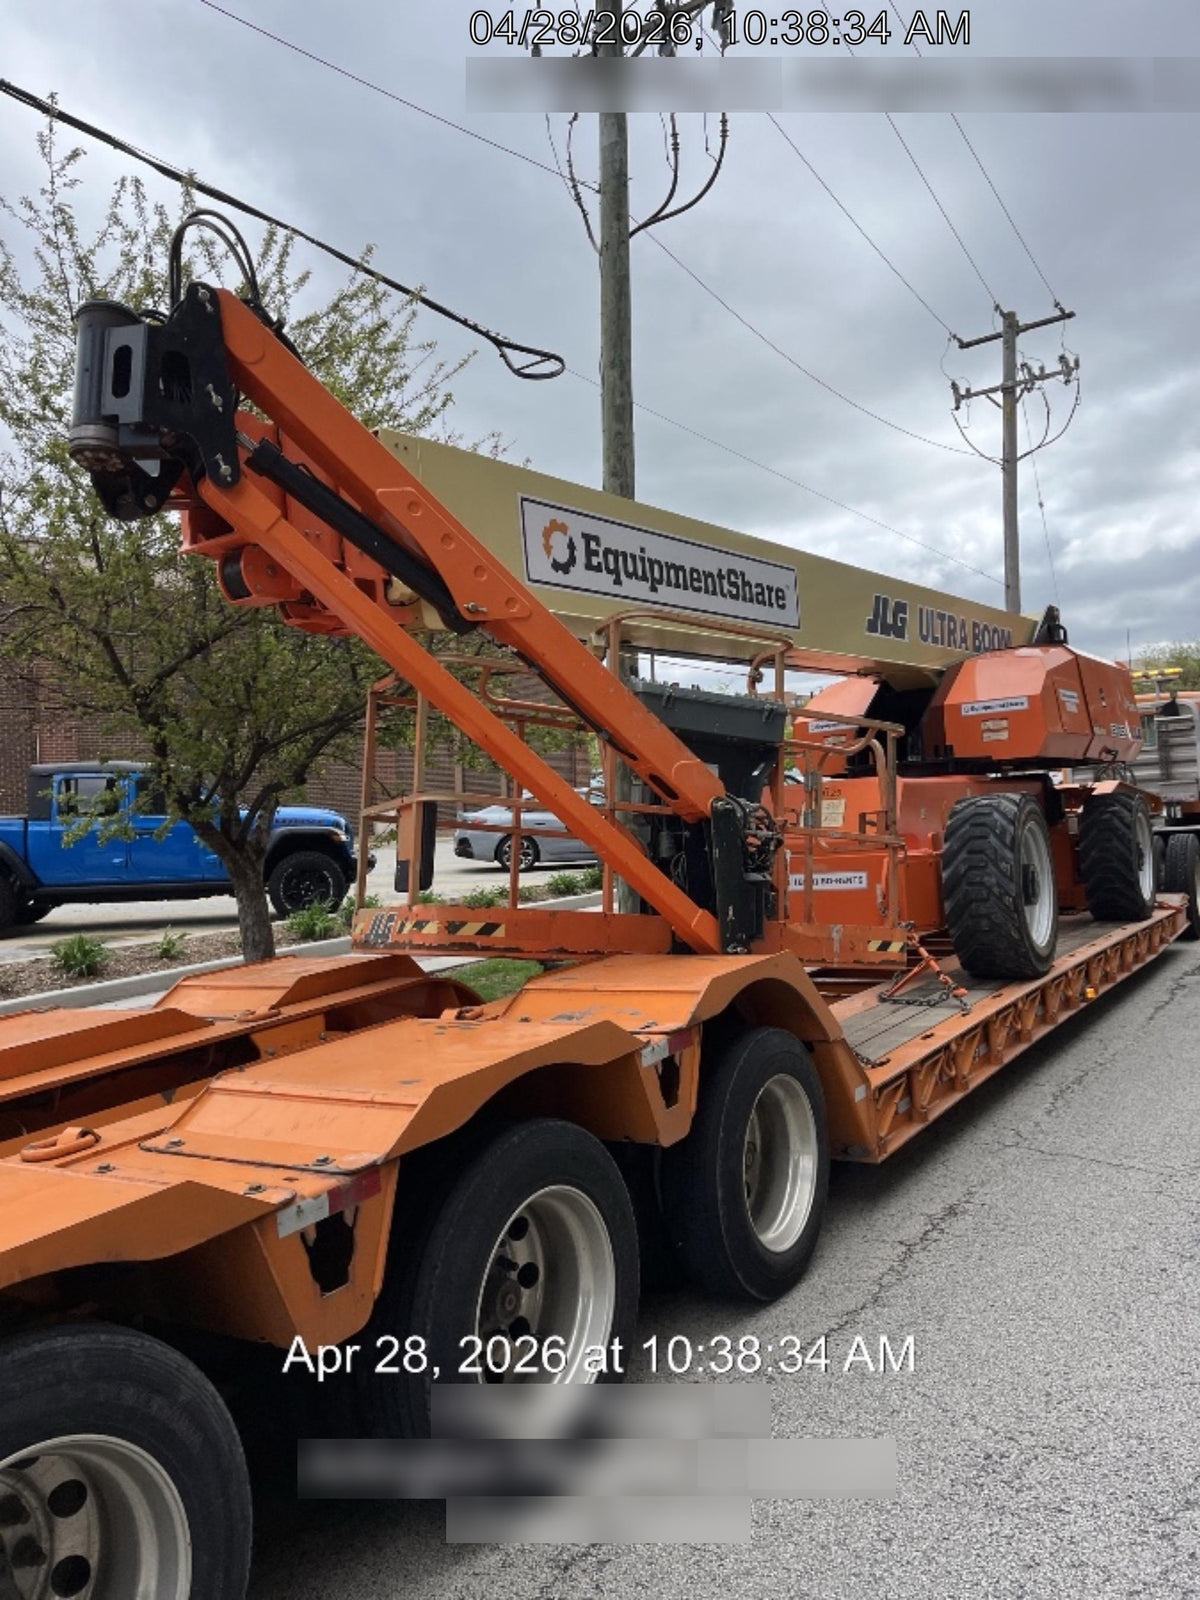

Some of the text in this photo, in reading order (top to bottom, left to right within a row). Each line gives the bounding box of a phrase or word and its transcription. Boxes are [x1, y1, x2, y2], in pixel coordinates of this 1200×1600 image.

[581, 531, 787, 611] EquipmentShare
[866, 593, 1012, 653] JLG ULTRA BOOM
